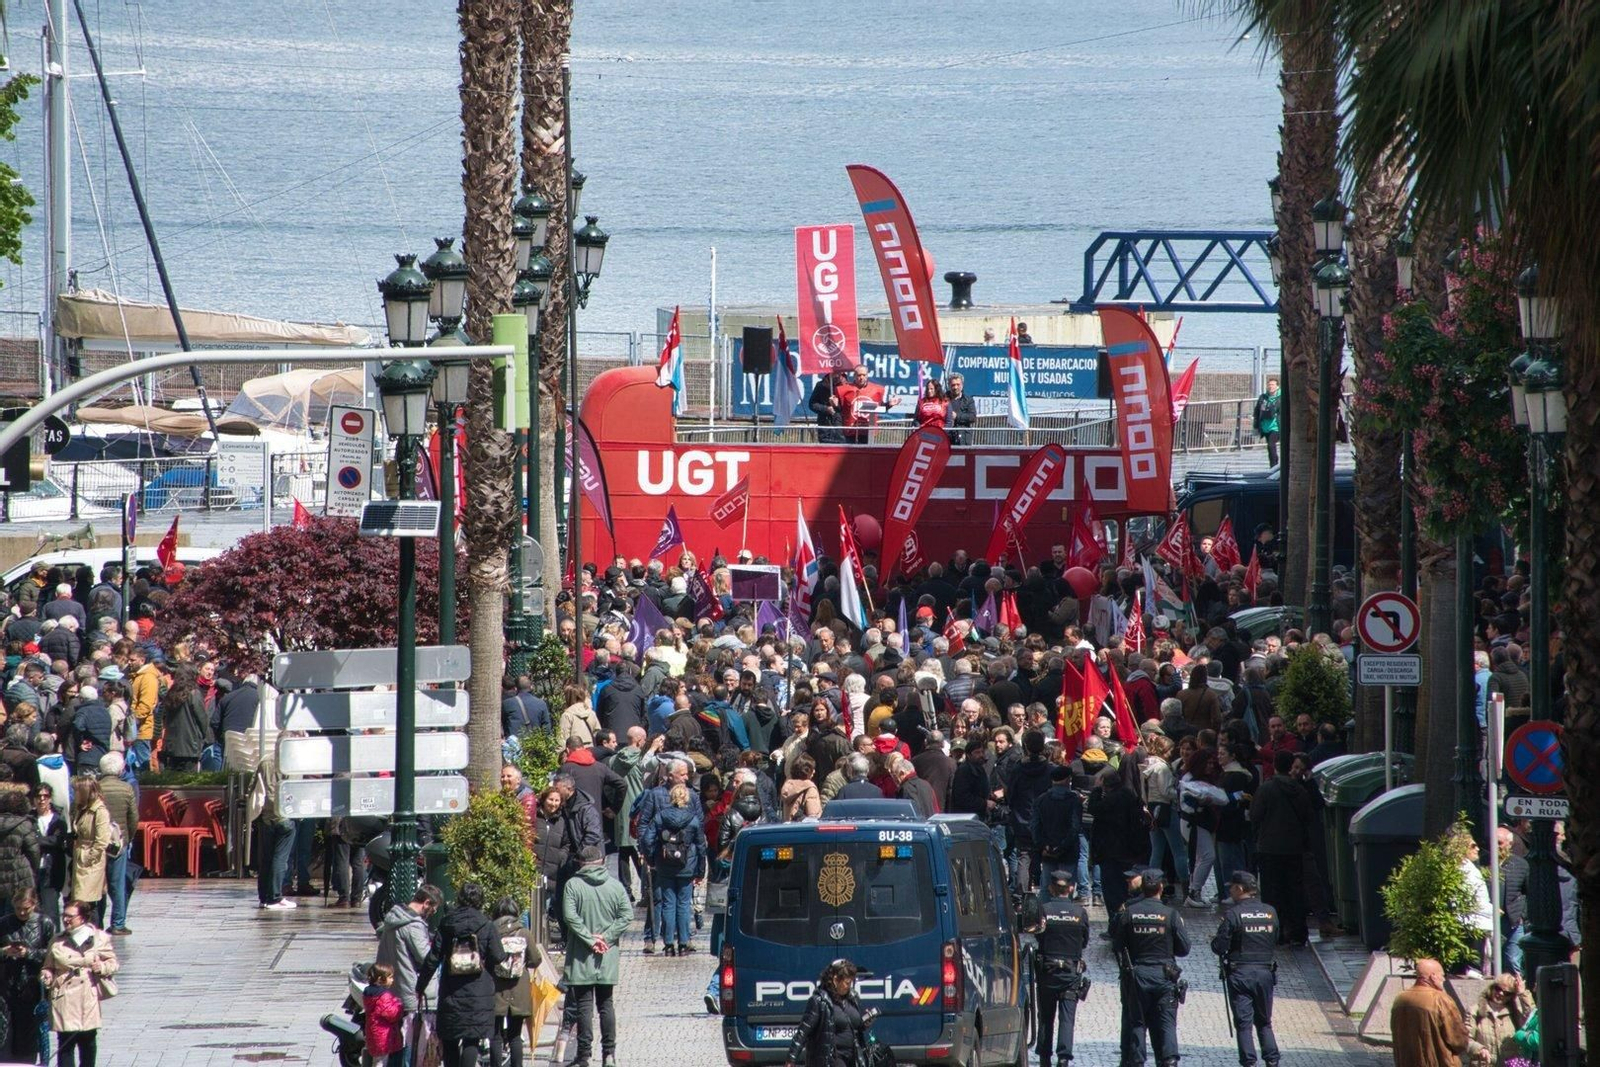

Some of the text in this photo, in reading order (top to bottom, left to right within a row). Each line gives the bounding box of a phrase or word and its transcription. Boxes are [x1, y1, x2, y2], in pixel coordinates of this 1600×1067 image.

[813, 229, 839, 324] UGT
[818, 359, 843, 369] VIGO
[957, 356, 1011, 370] COMPRAVEN
[1023, 358, 1035, 370] DE
[1030, 373, 1036, 384] Y
[1037, 373, 1074, 385] USADAS
[637, 449, 750, 496] UGT
[893, 441, 937, 520] CCOO
[879, 831, 913, 841] 8U-38
[756, 975, 920, 1002] POCÍA
